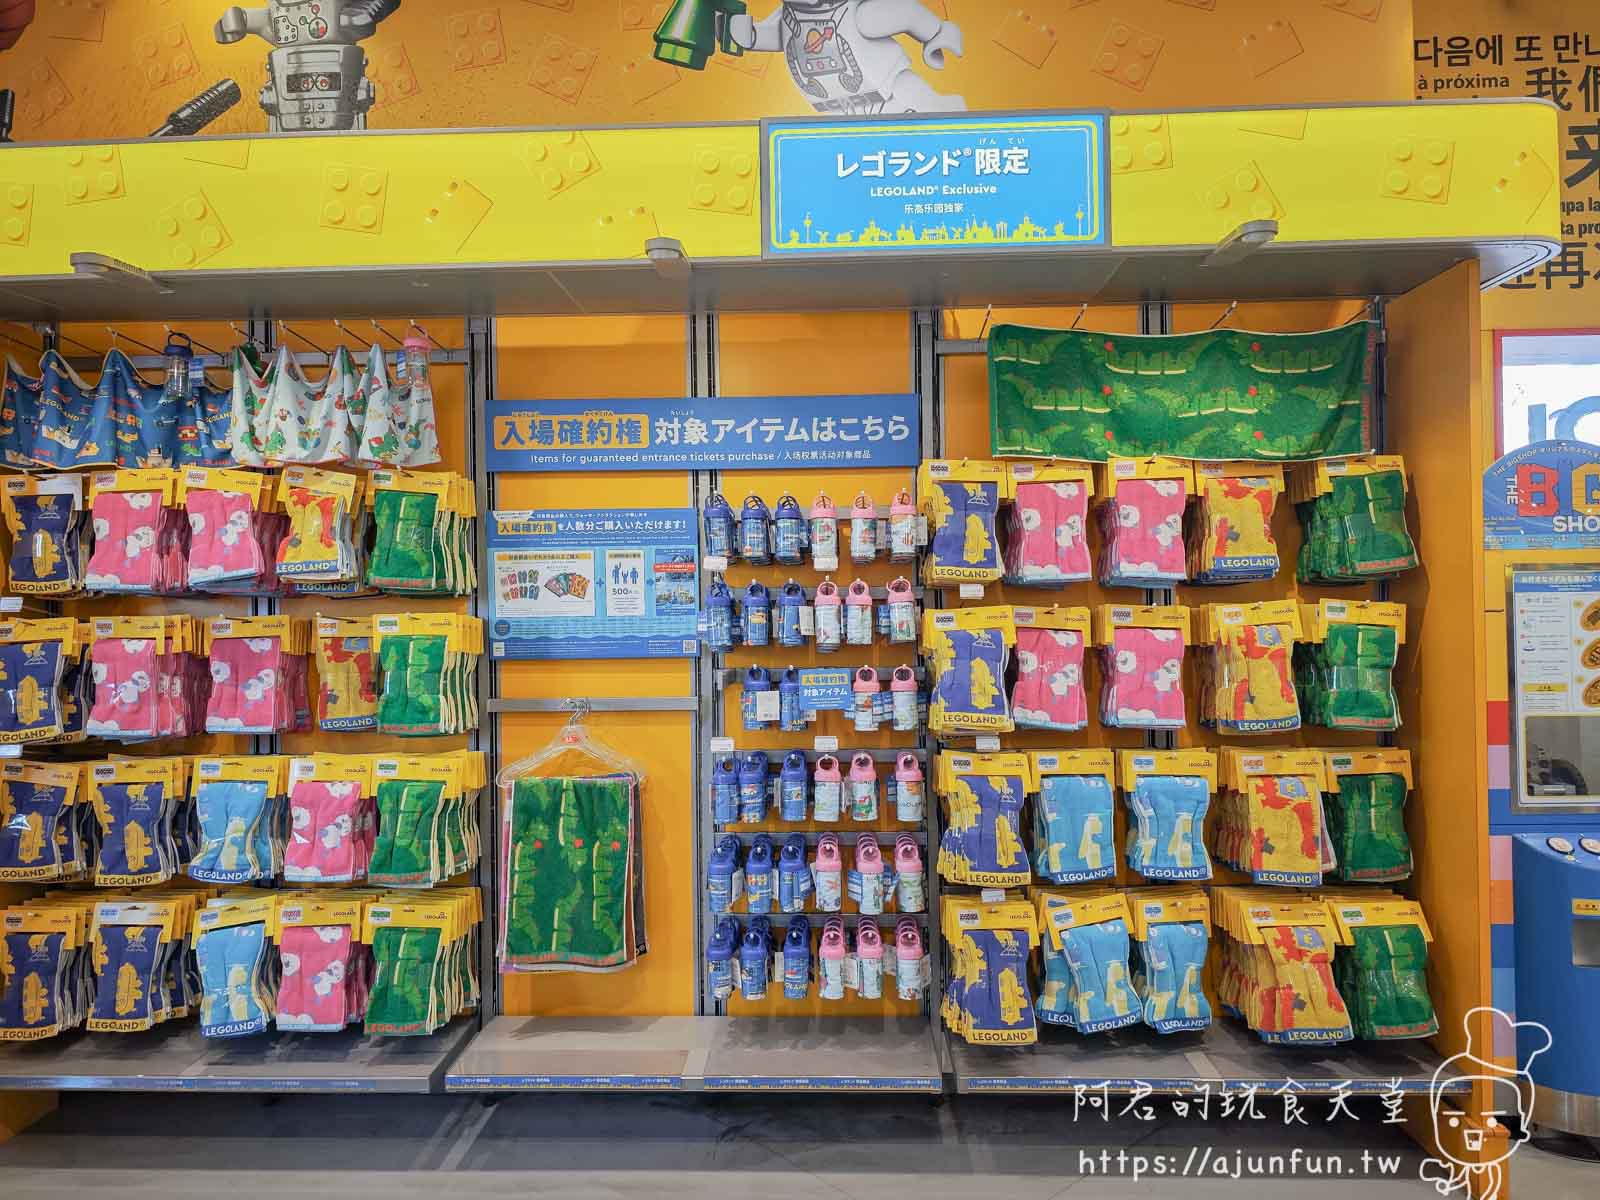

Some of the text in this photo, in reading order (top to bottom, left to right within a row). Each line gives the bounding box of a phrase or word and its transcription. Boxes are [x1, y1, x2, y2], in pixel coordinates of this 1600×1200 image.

[1414, 34, 1504, 68] 다음에
[1514, 35, 1544, 62] 또
[1418, 73, 1510, 93] à próxima
[942, 183, 997, 196] Exclusive
[655, 415, 910, 446] 対象アイテムはこちら
[531, 454, 559, 464] Items
[562, 453, 577, 464] for
[579, 452, 639, 465] guaranteed
[642, 452, 688, 463] entrance
[690, 452, 726, 463] tickets
[728, 450, 775, 463] purchase
[1505, 474, 1518, 505] THE
[1552, 515, 1600, 533] SHO
[0, 729, 47, 742] GOLAND
[1047, 1012, 1075, 1023] LEGOL
